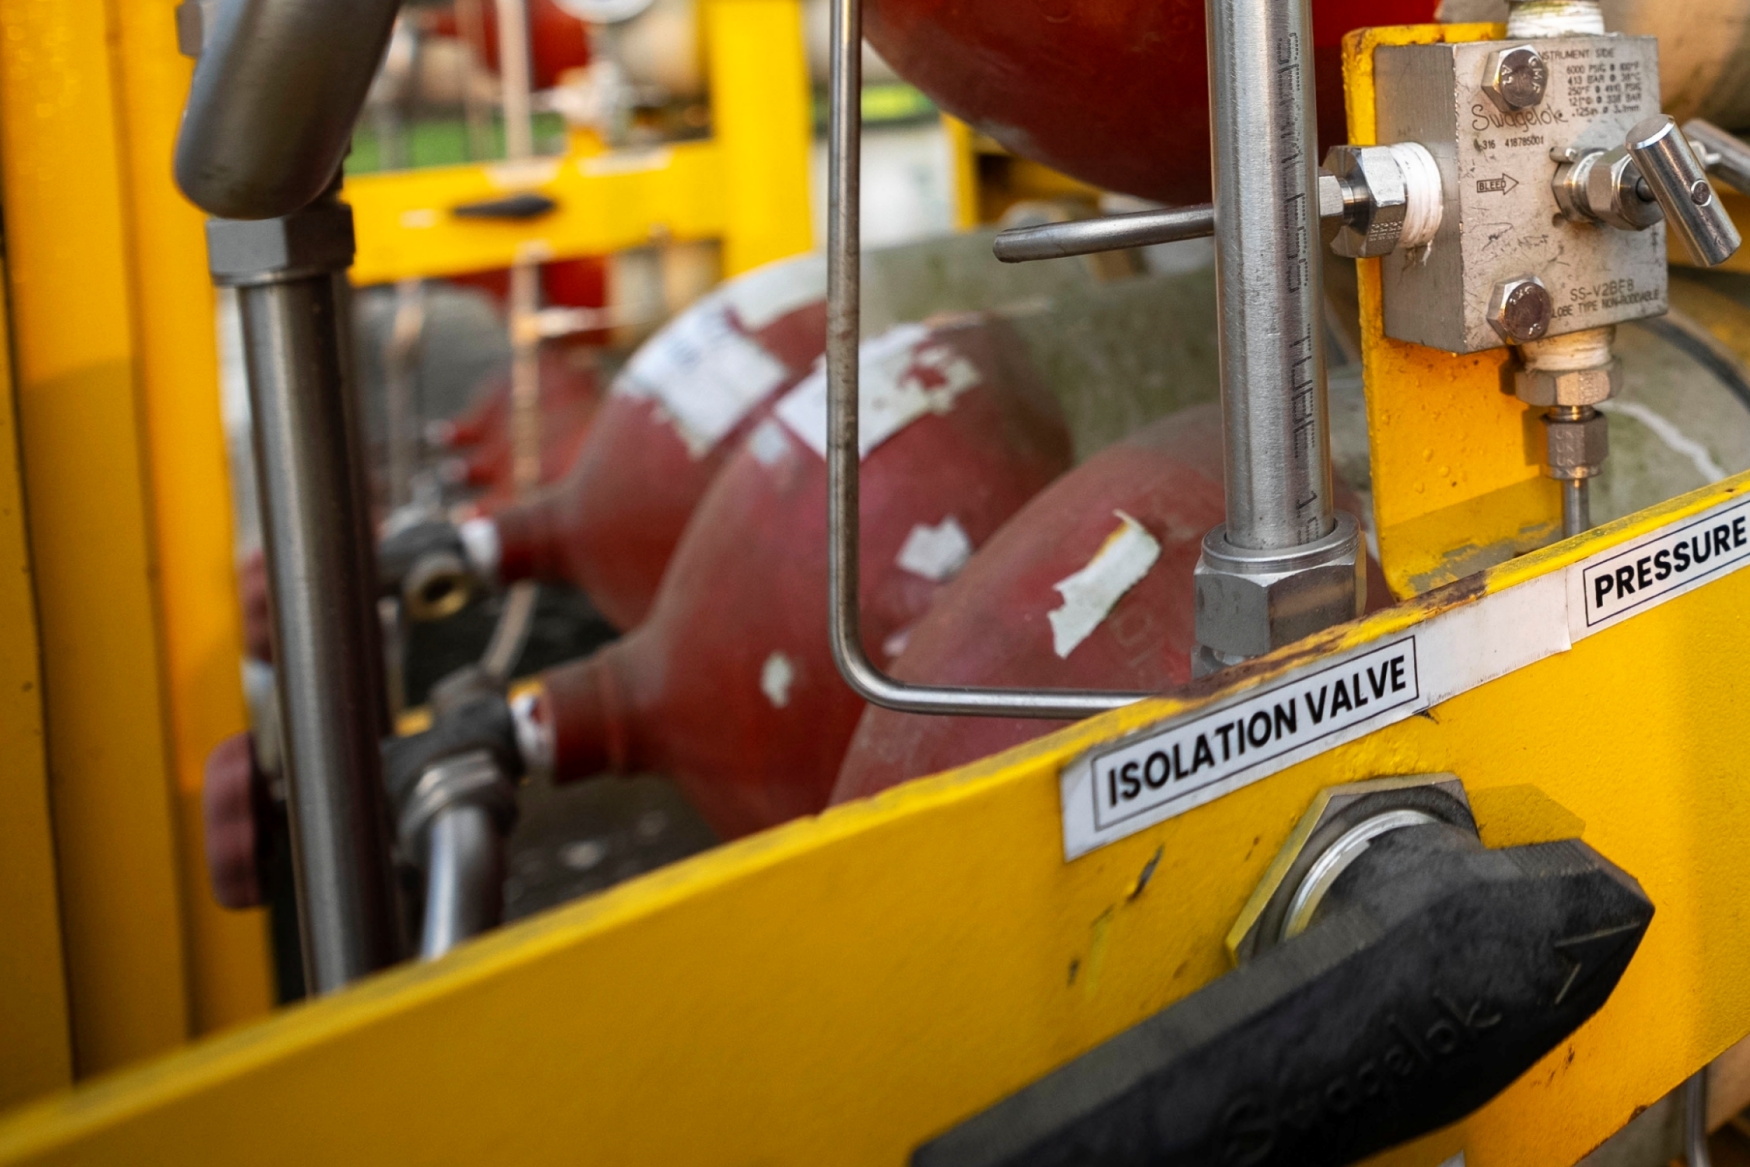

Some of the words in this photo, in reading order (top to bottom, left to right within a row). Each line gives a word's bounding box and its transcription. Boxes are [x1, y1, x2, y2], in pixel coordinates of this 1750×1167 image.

[1538, 49, 1590, 61] NSTRUMENT
[1595, 47, 1615, 58] SIDE
[1566, 64, 1586, 74] 6000
[1567, 76, 1582, 85] 413
[1471, 103, 1568, 132] Swagelok
[1482, 140, 1496, 150] 316
[1479, 180, 1506, 190] BLEED
[1551, 304, 1574, 319] LOBE
[1579, 300, 1599, 314] TYPE
[1288, 323, 1316, 459] TUBE
[1593, 515, 1746, 609] PRESSURE
[1106, 695, 1299, 810] ISOLATION
[1304, 654, 1407, 727] VALVE
